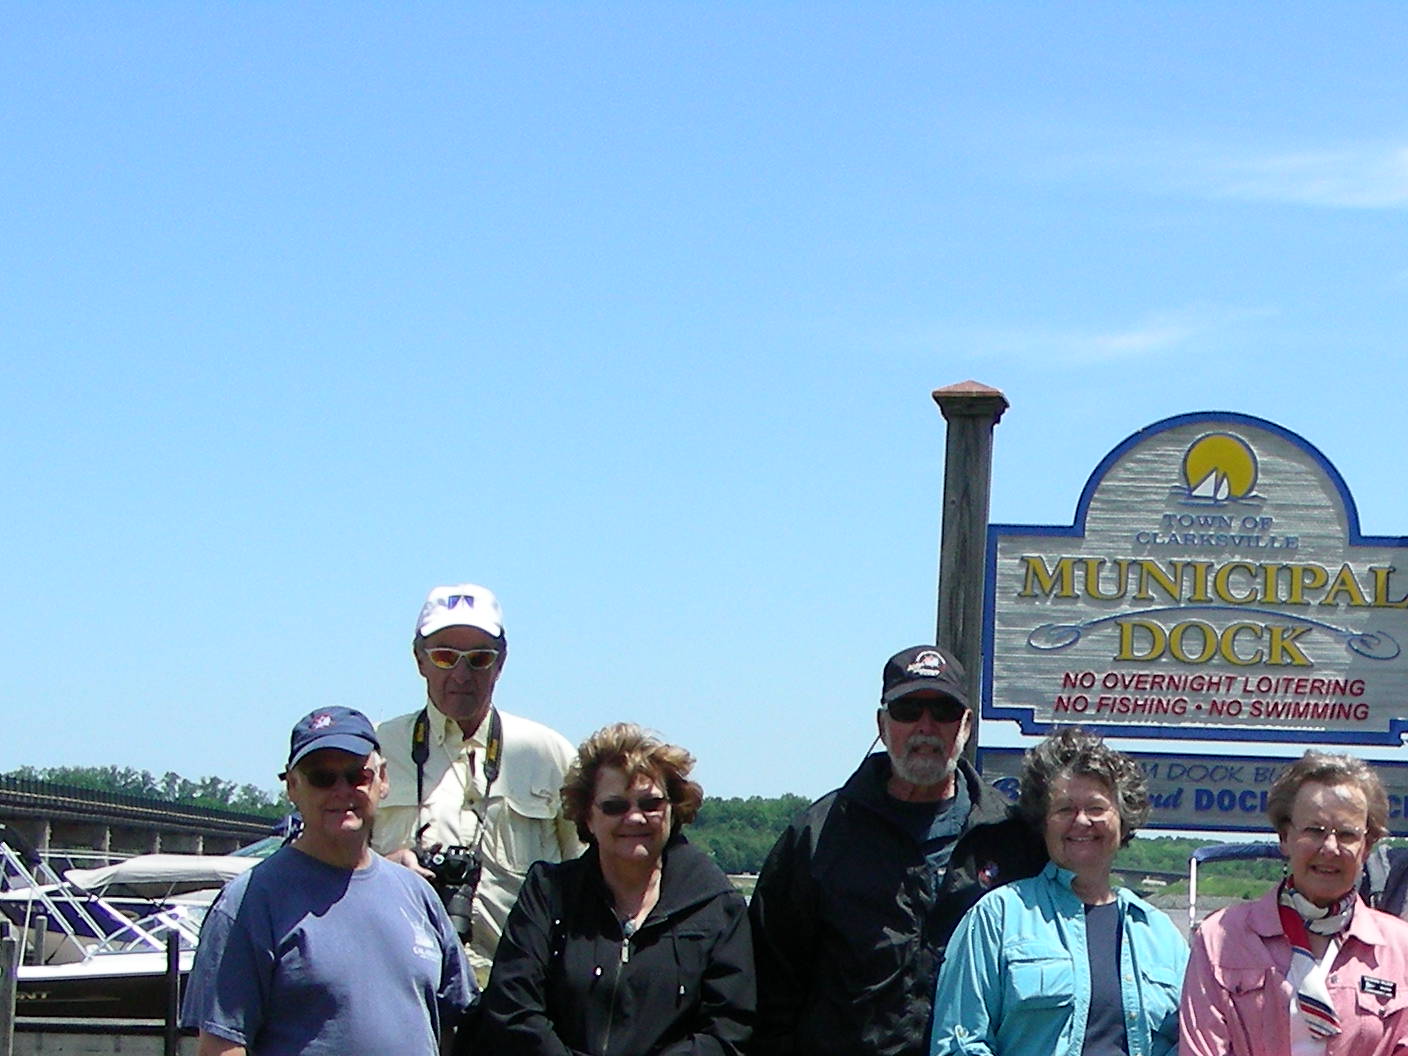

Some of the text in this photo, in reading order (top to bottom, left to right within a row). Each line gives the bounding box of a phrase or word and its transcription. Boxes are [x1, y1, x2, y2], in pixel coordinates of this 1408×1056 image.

[1163, 513, 1274, 530] TOWN OF
[1136, 531, 1299, 549] CLARKSVILLE
[1113, 619, 1313, 667] DOCK
[1062, 671, 1366, 696] NO OVERNIGHT LOITERING
[1054, 695, 1370, 721] NO FISHING NO SWIMMING
[1148, 787, 1184, 809] nd
